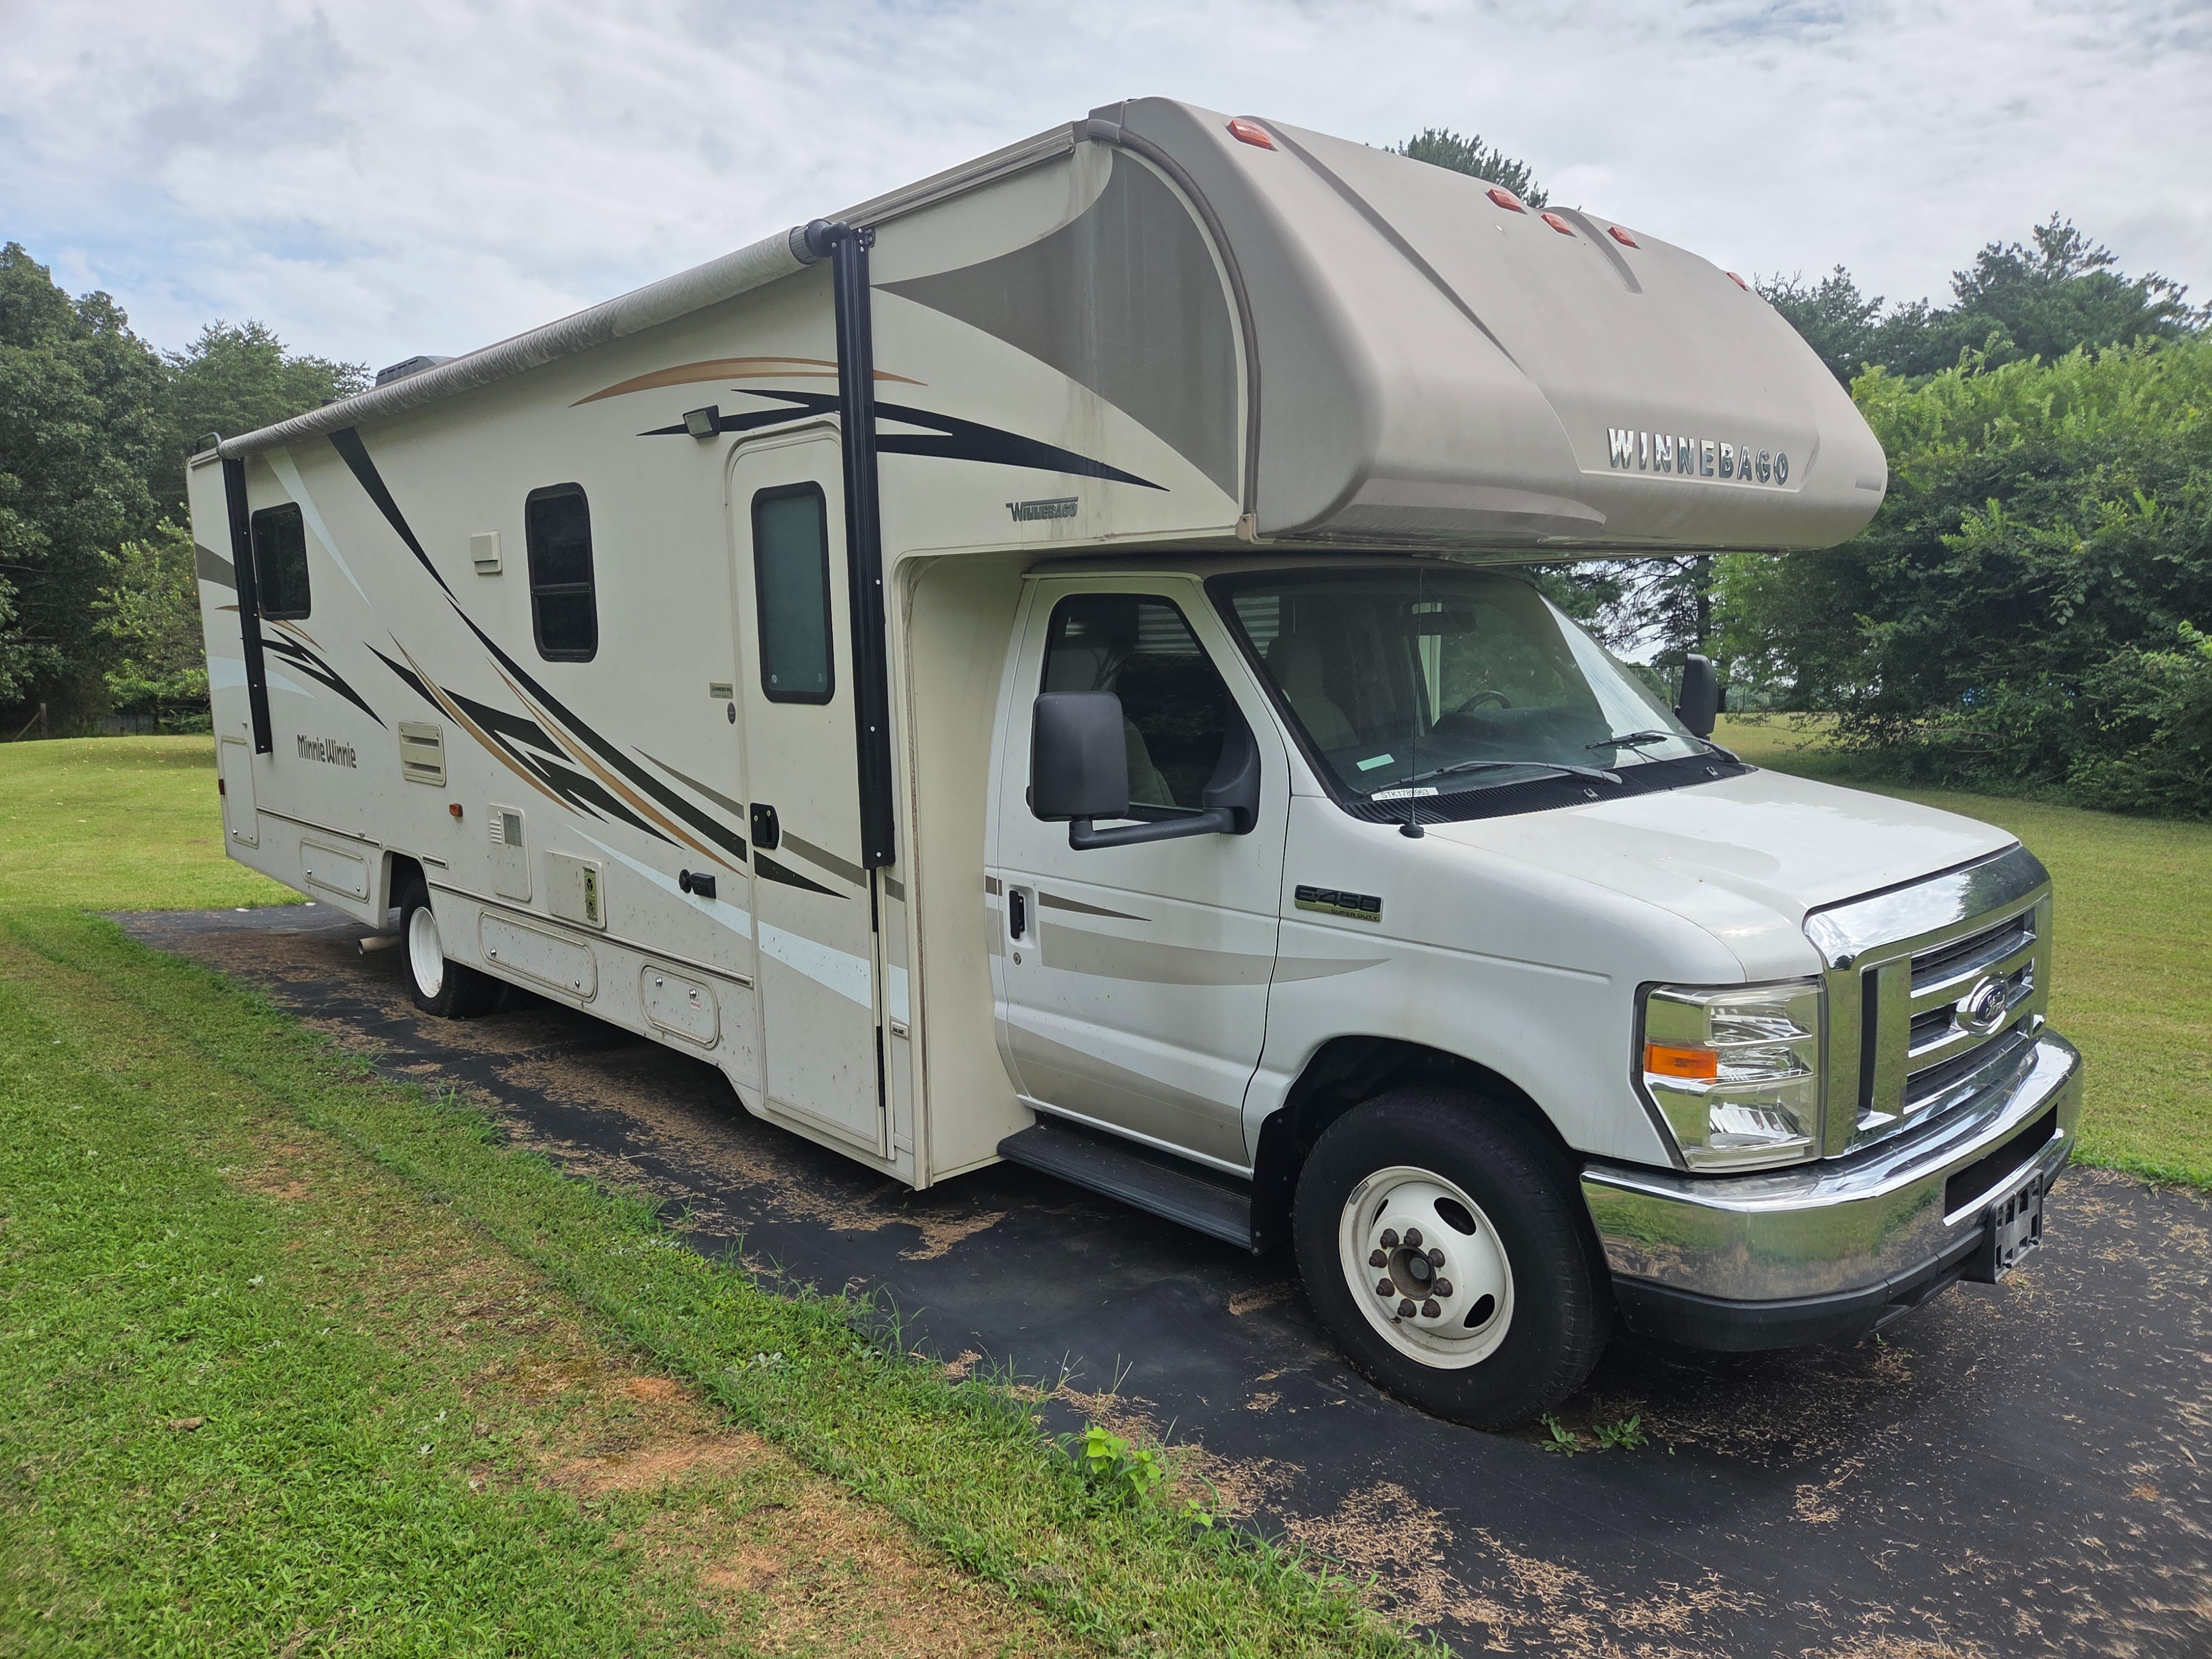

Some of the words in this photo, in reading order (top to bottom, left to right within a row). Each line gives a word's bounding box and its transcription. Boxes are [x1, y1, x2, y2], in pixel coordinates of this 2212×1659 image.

[1607, 427, 1788, 486] WINNEBAGO
[1005, 497, 1078, 521] WINNEBAGO
[297, 734, 326, 763] Minnie
[325, 738, 357, 769] Winnie
[1331, 909, 1355, 917] SUPER
